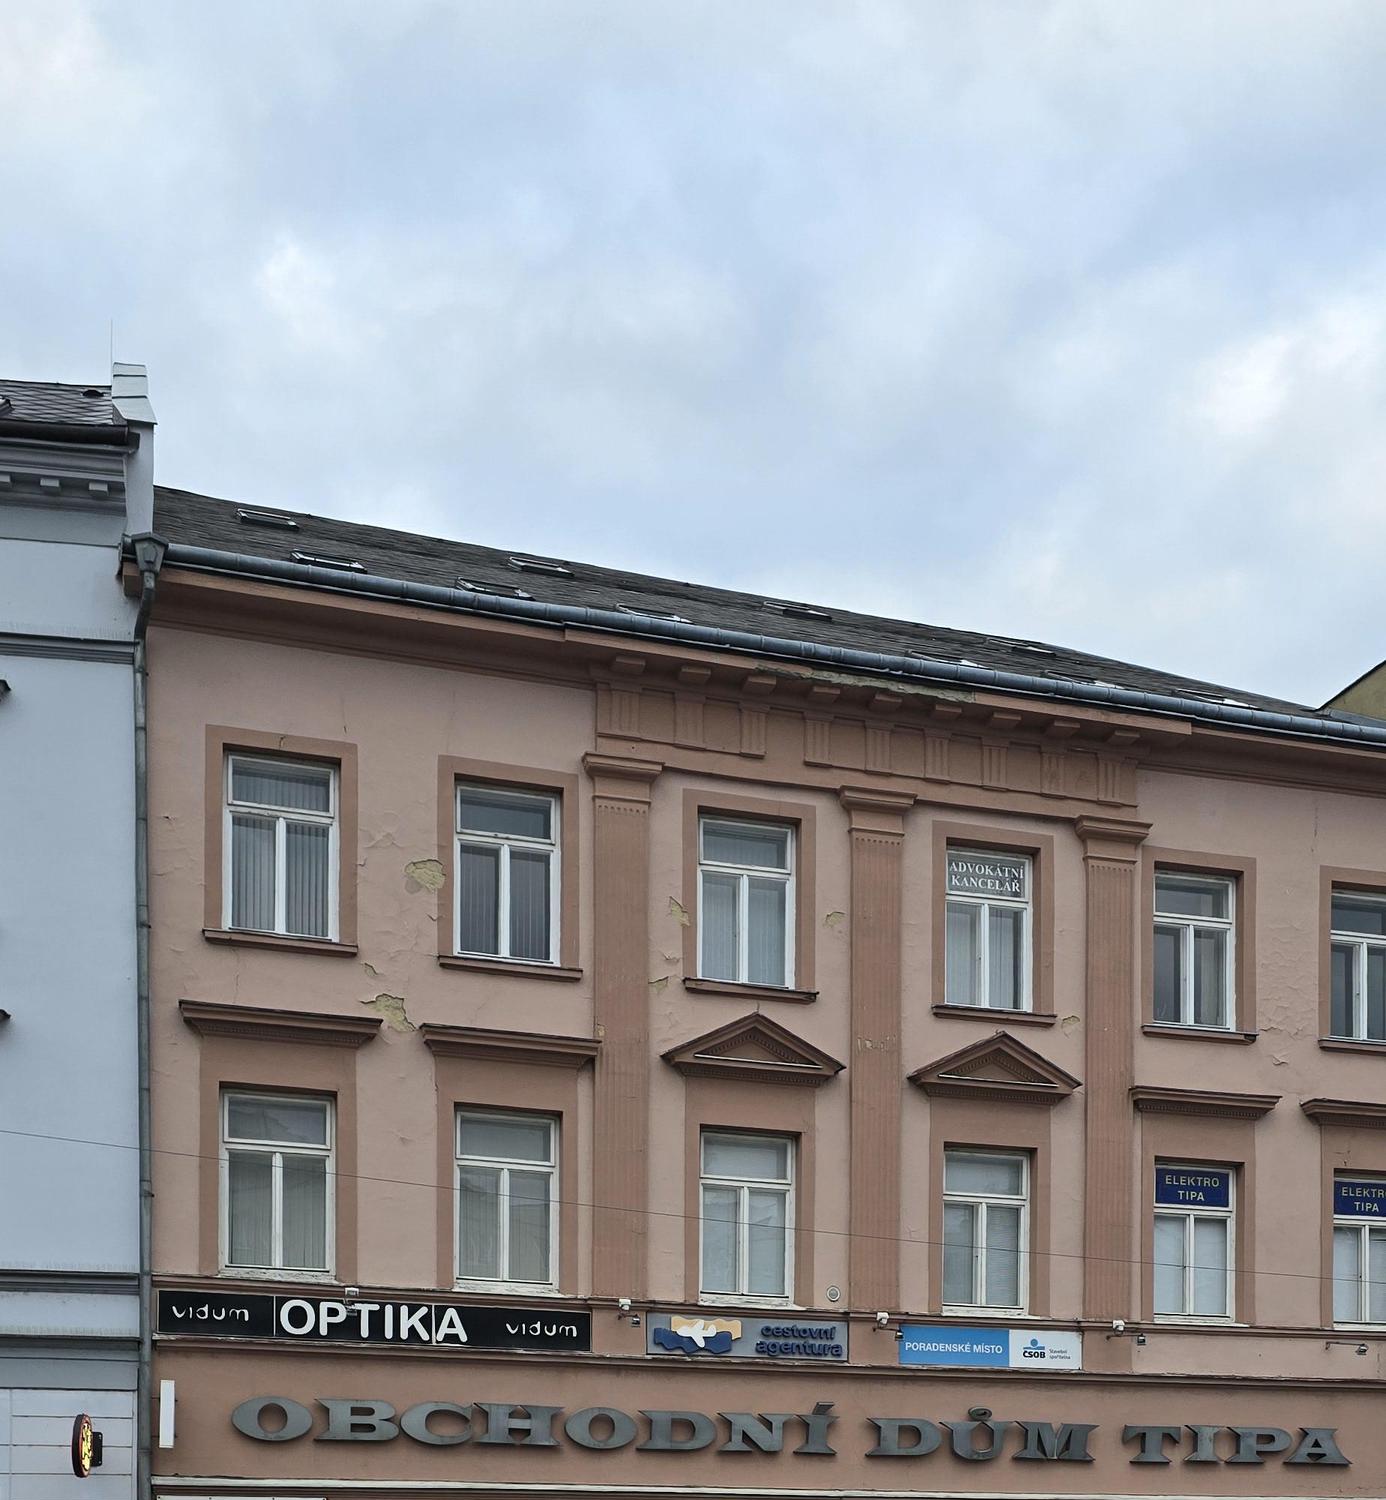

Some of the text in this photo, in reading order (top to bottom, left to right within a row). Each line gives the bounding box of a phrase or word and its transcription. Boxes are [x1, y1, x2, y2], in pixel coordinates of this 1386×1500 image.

[950, 862, 1024, 879] ADVOKÁTNÍ
[951, 875, 1020, 892] KANCELÁŘ
[1165, 1175, 1219, 1187] ELEKTRO
[1178, 1190, 1204, 1201] TIPA
[1341, 1186, 1386, 1198] ELEKTR
[1354, 1202, 1379, 1212] TIPA
[172, 1304, 249, 1321] vidum
[279, 1299, 468, 1343] OPTIKA
[506, 1321, 577, 1337] vidum
[761, 1324, 836, 1340] cestovní
[755, 1341, 842, 1357] agentura
[905, 1342, 1003, 1354] PORADENSKÉ MÍSTO
[1022, 1350, 1046, 1359] ČSOB
[231, 1396, 1352, 1465] OBCHODNÍ DŮM TIPA
